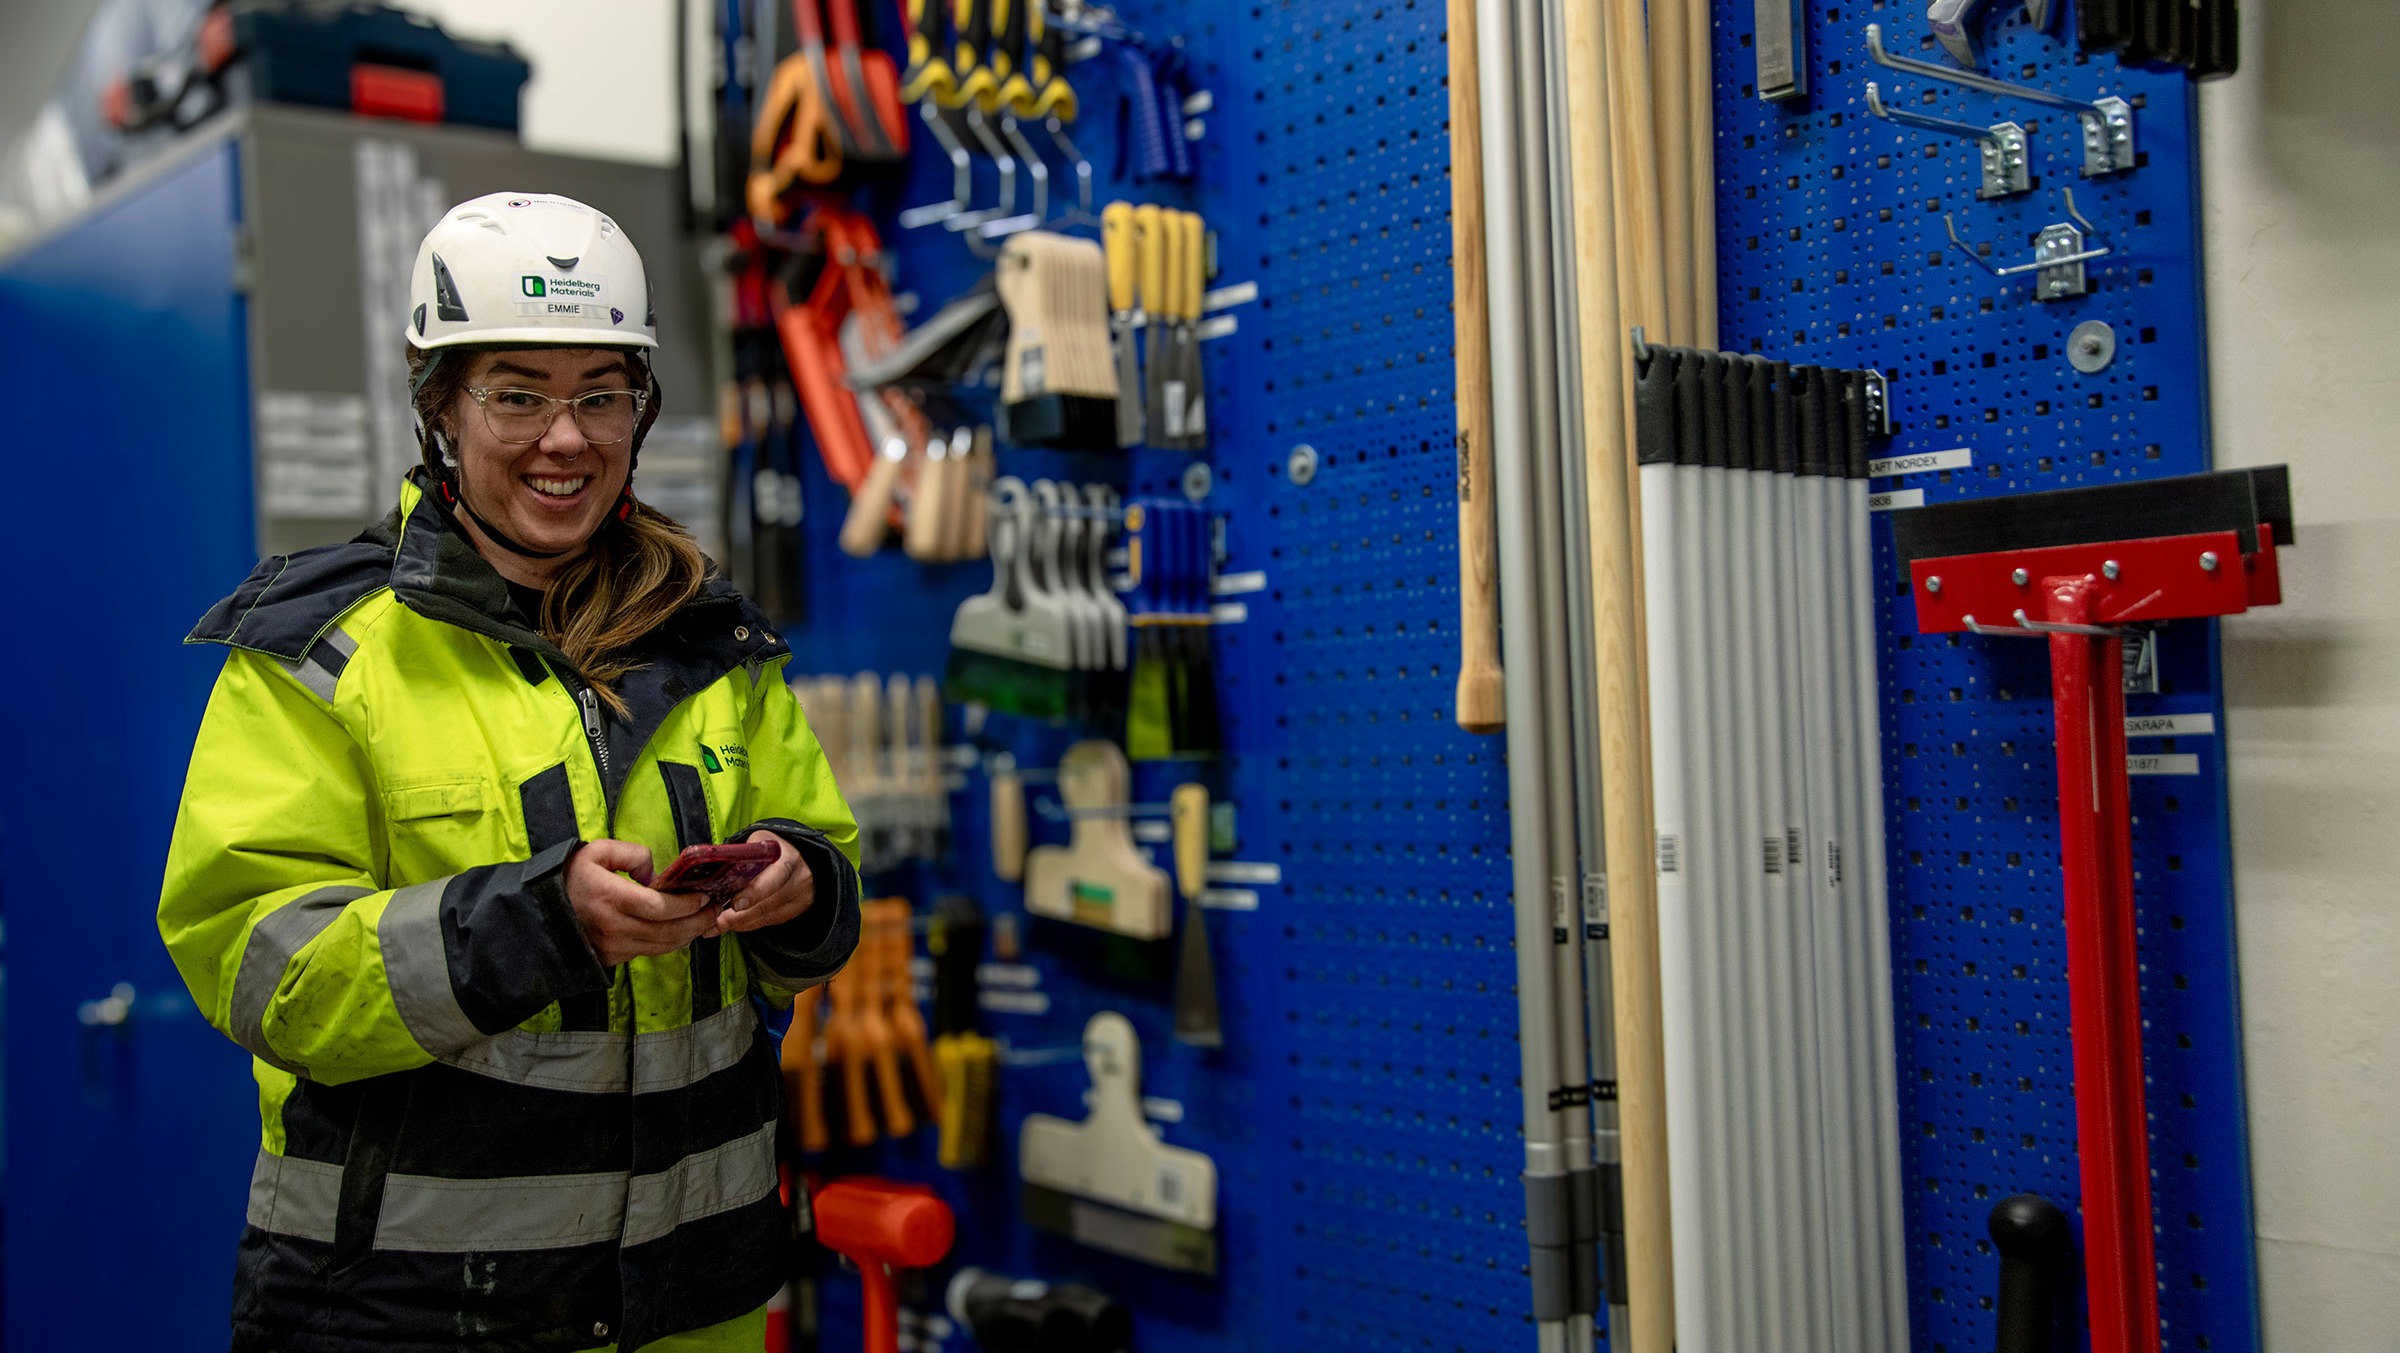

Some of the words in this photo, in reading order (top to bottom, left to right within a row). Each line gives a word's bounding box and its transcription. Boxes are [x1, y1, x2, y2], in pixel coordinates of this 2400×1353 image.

[550, 279, 600, 291] Heidelberg
[550, 287, 595, 297] Materials
[547, 304, 580, 313] EMMIE
[1894, 456, 1938, 470] NORDEX
[2125, 719, 2174, 731] SKRAPA
